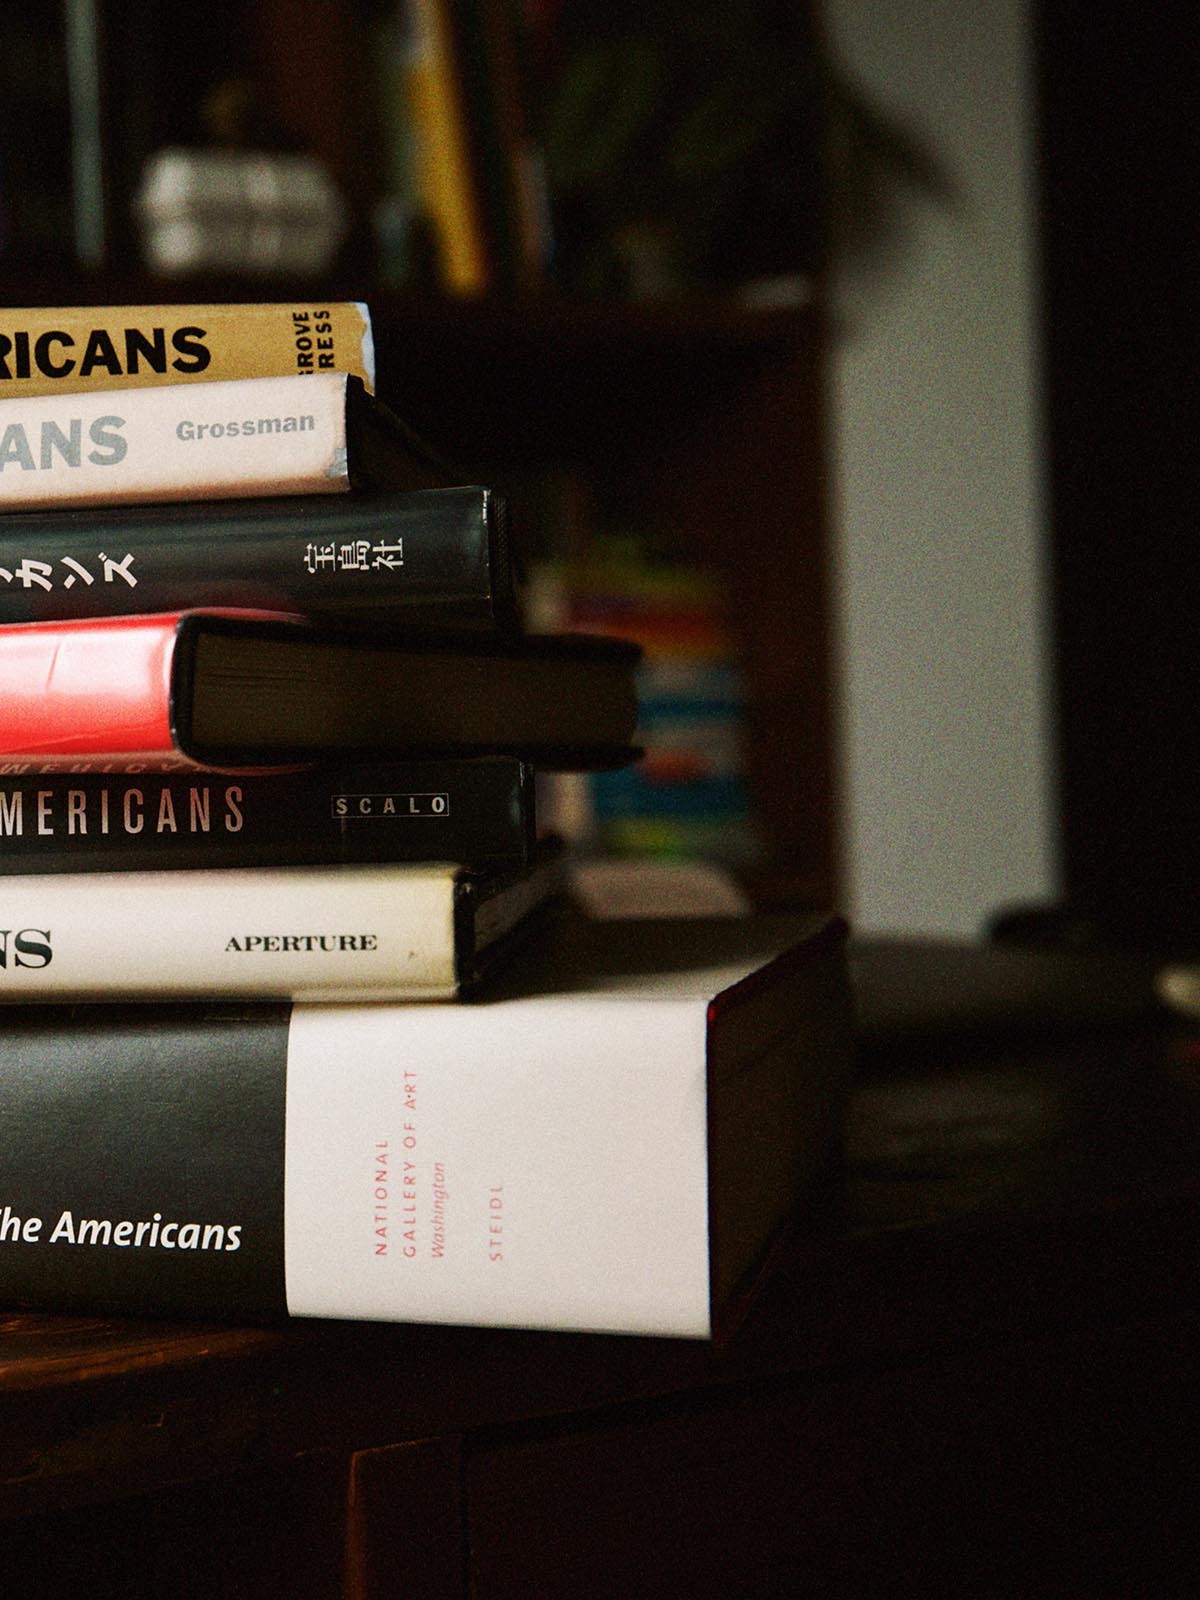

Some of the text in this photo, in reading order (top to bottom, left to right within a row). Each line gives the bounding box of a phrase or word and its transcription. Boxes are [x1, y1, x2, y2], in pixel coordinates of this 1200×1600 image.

[313, 310, 334, 369] RESS
[175, 414, 316, 442] Grossman
[303, 537, 404, 574] 宝島社
[335, 796, 446, 815] SCALO
[224, 934, 379, 952] APERTURE
[403, 1122, 417, 1150] OF
[374, 1141, 389, 1257] NATIONAL
[403, 1160, 417, 1258] GALLERY
[430, 1162, 450, 1259] Washington
[49, 1210, 242, 1251] Americans
[488, 1185, 504, 1262] STEIDL
